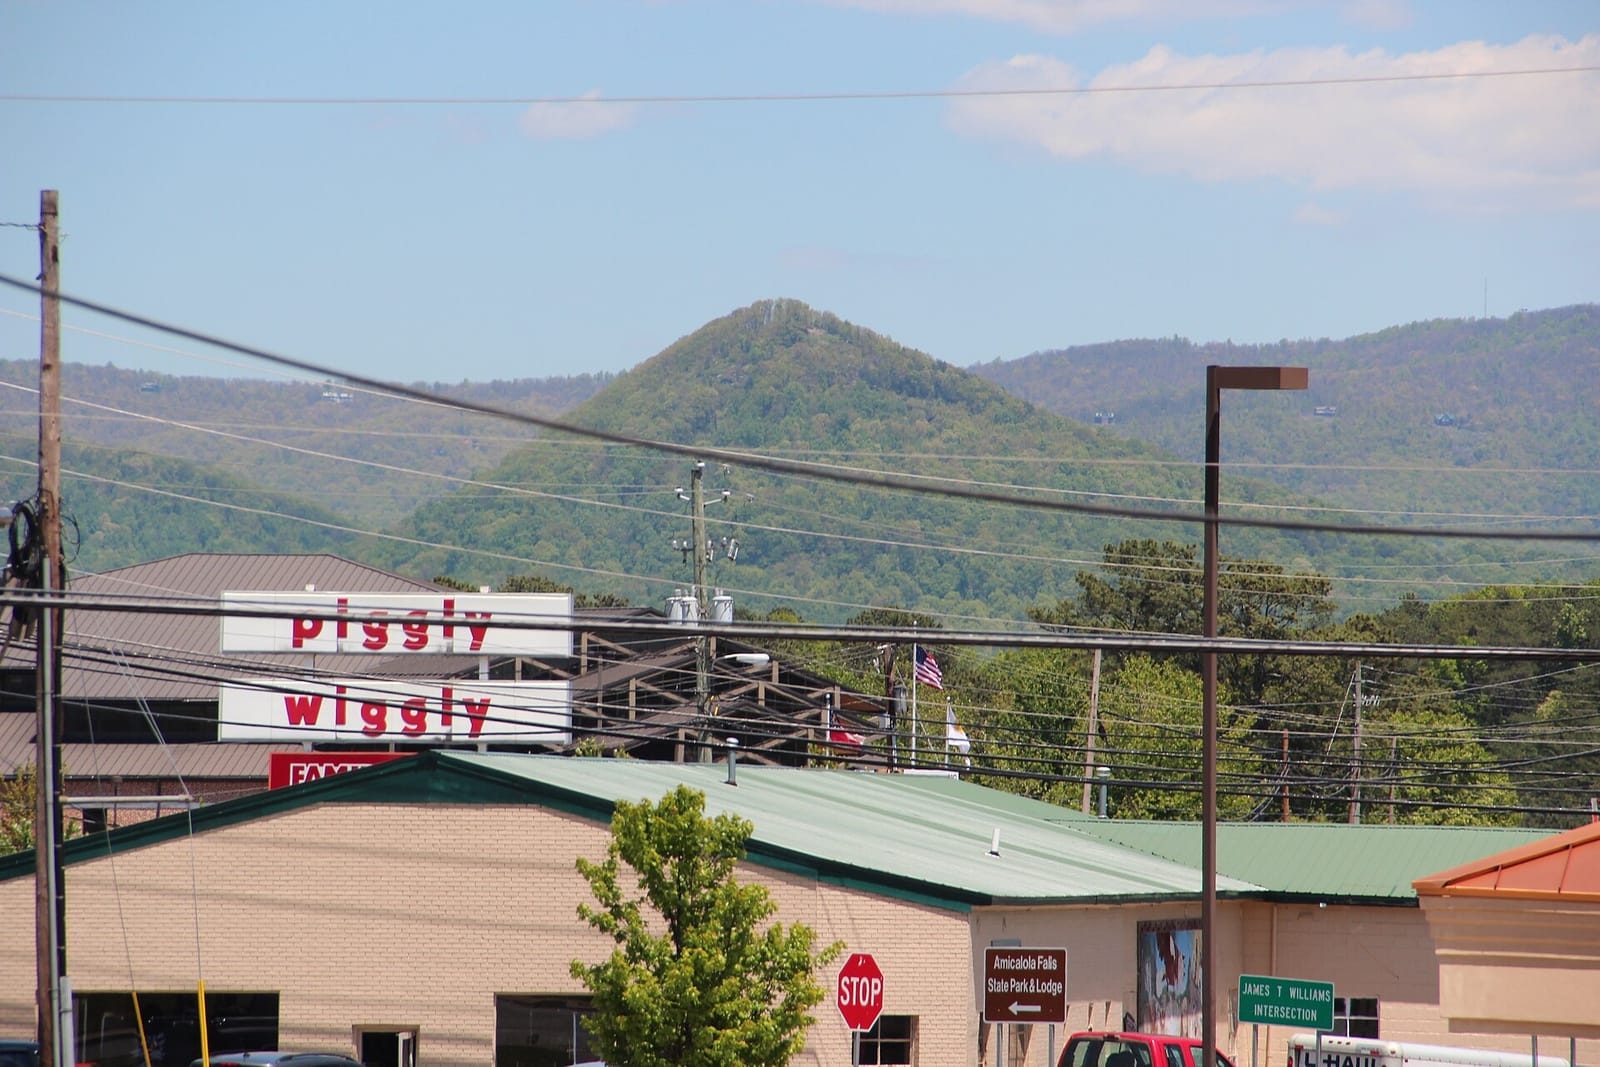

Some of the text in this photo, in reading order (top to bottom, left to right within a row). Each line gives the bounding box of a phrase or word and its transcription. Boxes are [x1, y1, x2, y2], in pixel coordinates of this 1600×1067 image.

[292, 598, 491, 650] piggly
[284, 685, 491, 738] wiggly
[994, 955, 1057, 970] Amicalola Falls
[840, 976, 881, 1006] STOP
[988, 978, 1063, 996] State Park & Lodge
[1243, 983, 1331, 1002] JAMES T WILLIAMS
[1254, 1004, 1317, 1021] INTERSECTION
